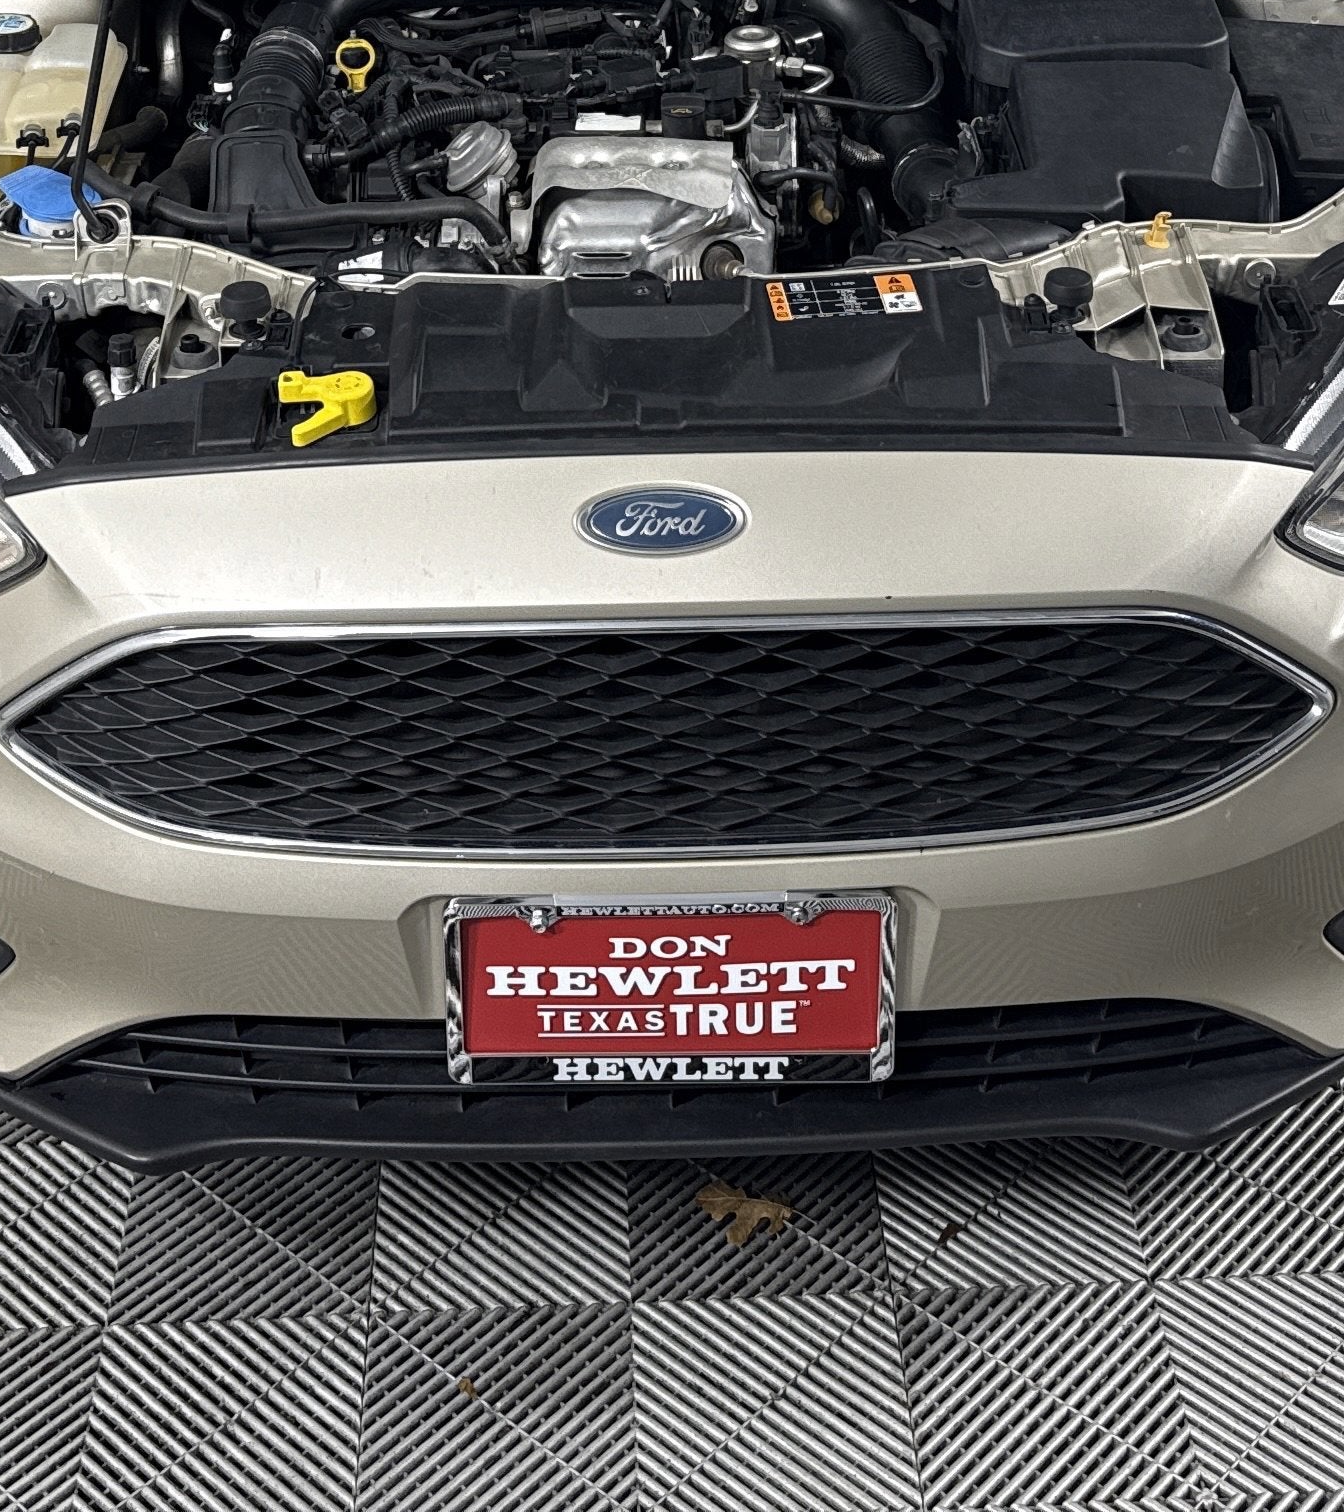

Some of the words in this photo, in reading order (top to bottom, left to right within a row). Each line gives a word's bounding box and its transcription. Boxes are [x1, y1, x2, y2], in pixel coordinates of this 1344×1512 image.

[615, 501, 708, 537] Ford
[560, 903, 781, 916] HEWLETTAUTO.COM
[608, 934, 732, 959] DON
[485, 958, 856, 996] HEWLETT
[552, 1056, 790, 1081] HEWLETT
